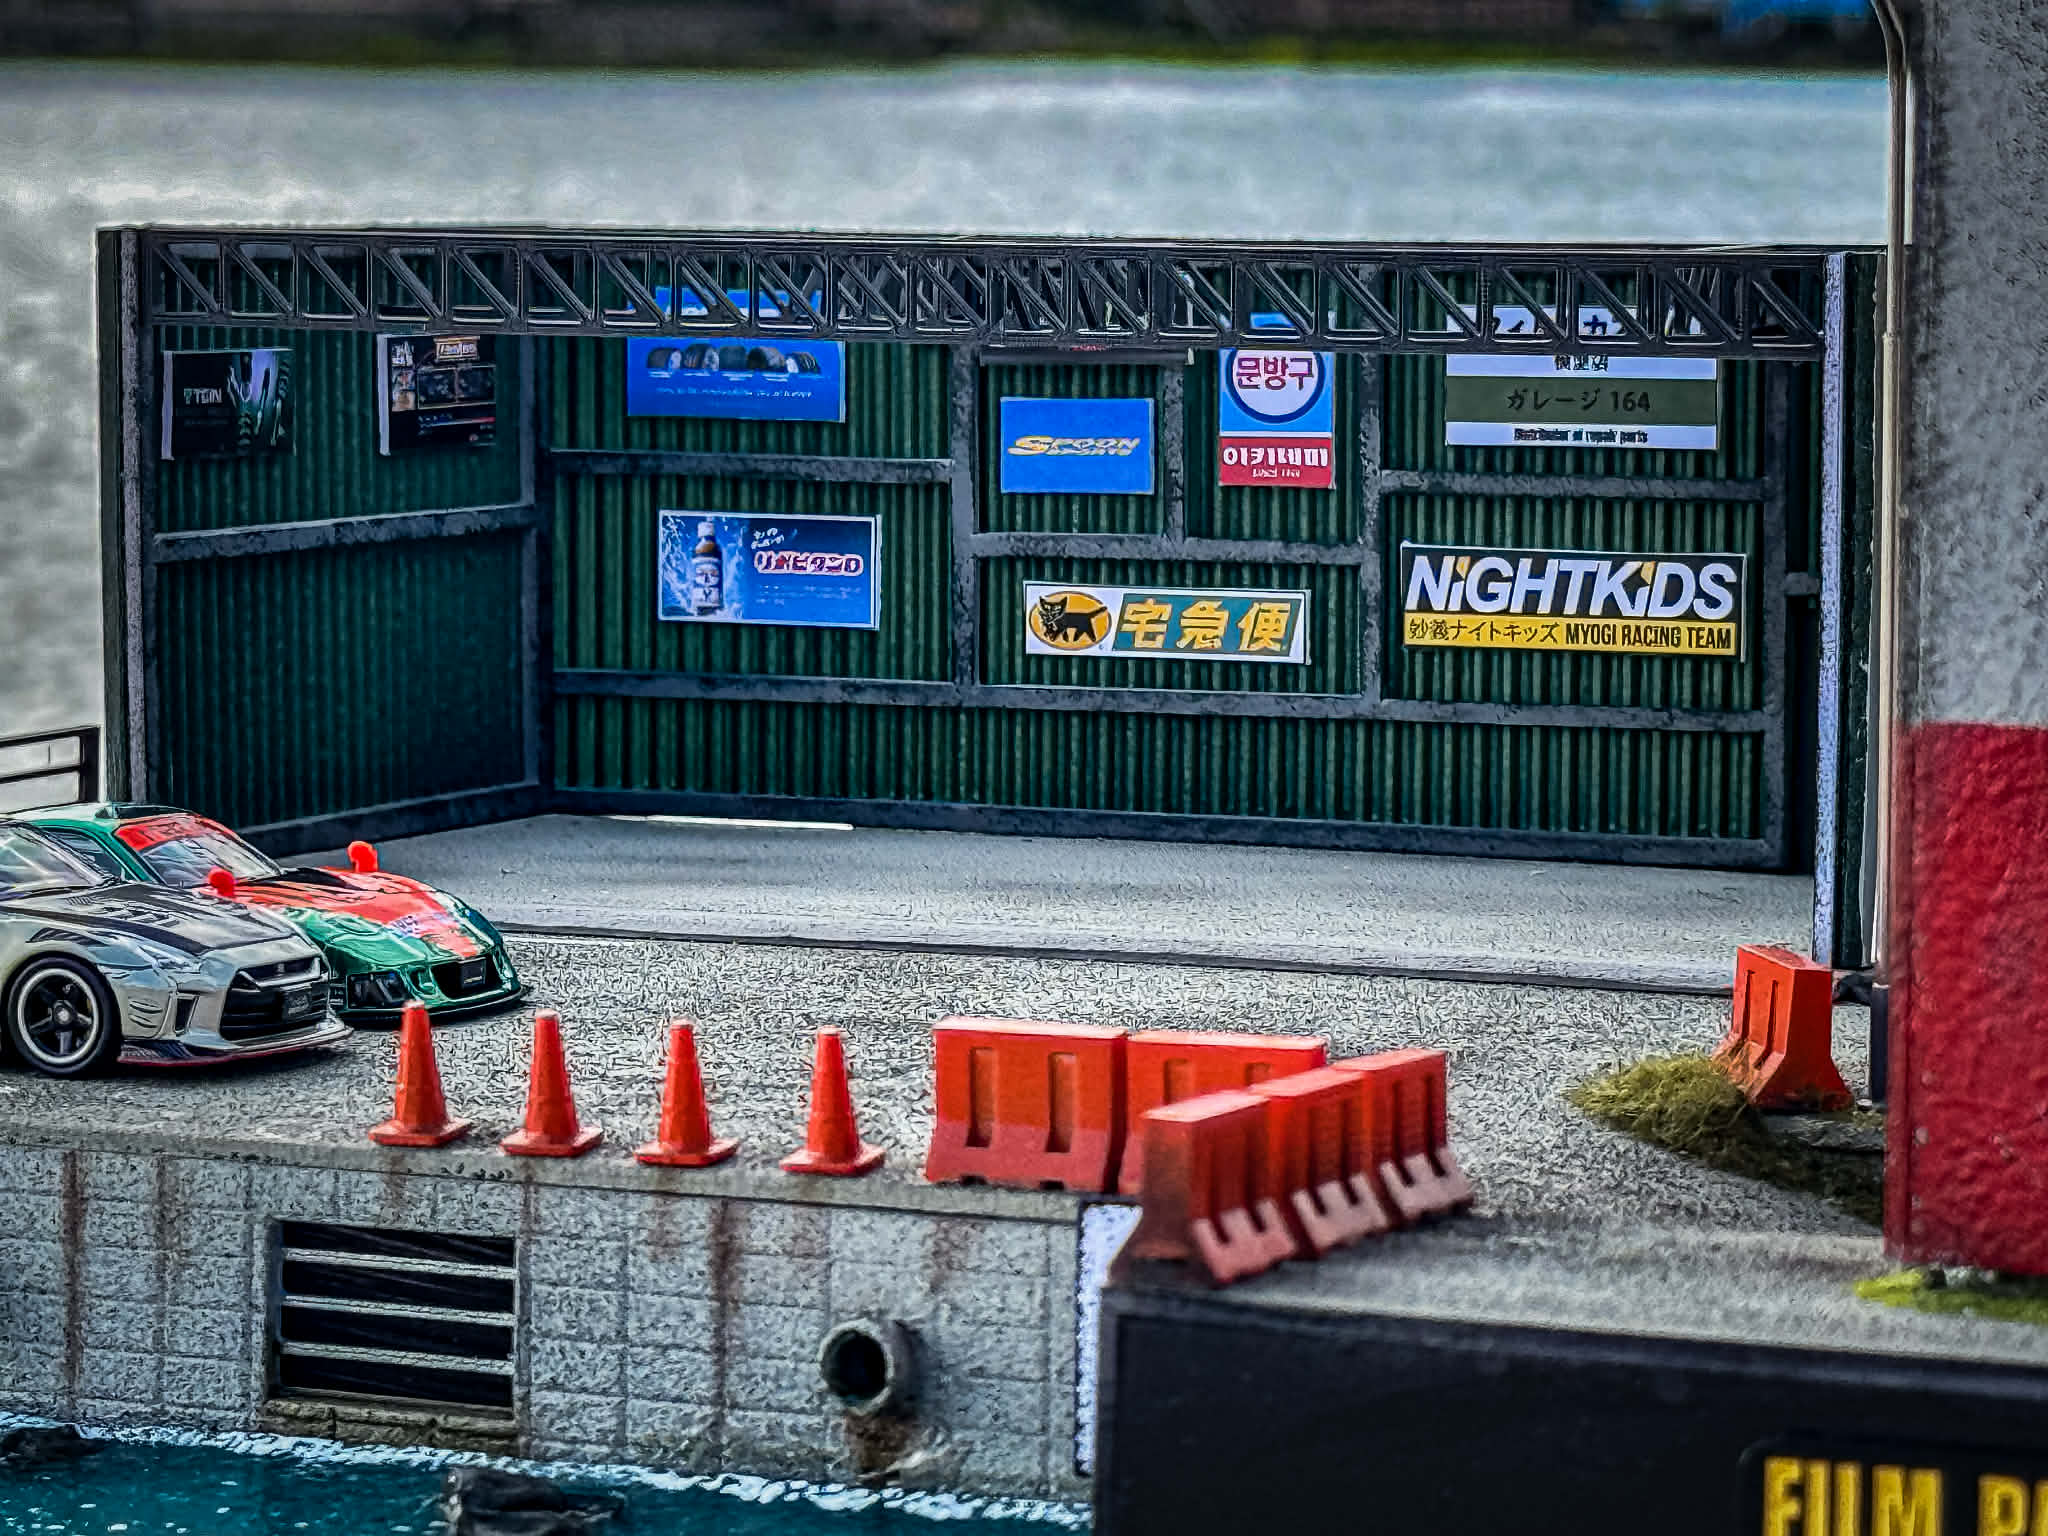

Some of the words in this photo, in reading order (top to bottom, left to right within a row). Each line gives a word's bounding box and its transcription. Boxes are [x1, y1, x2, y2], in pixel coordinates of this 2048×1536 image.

[1236, 355, 1315, 391] 문방구
[1506, 388, 1601, 412] ガレージ
[1610, 391, 1651, 413] 164
[1118, 597, 1293, 652] 宅急便
[1565, 622, 1617, 645] MYOGI
[1621, 624, 1682, 648] RACING
[1686, 626, 1731, 649] TEAM
